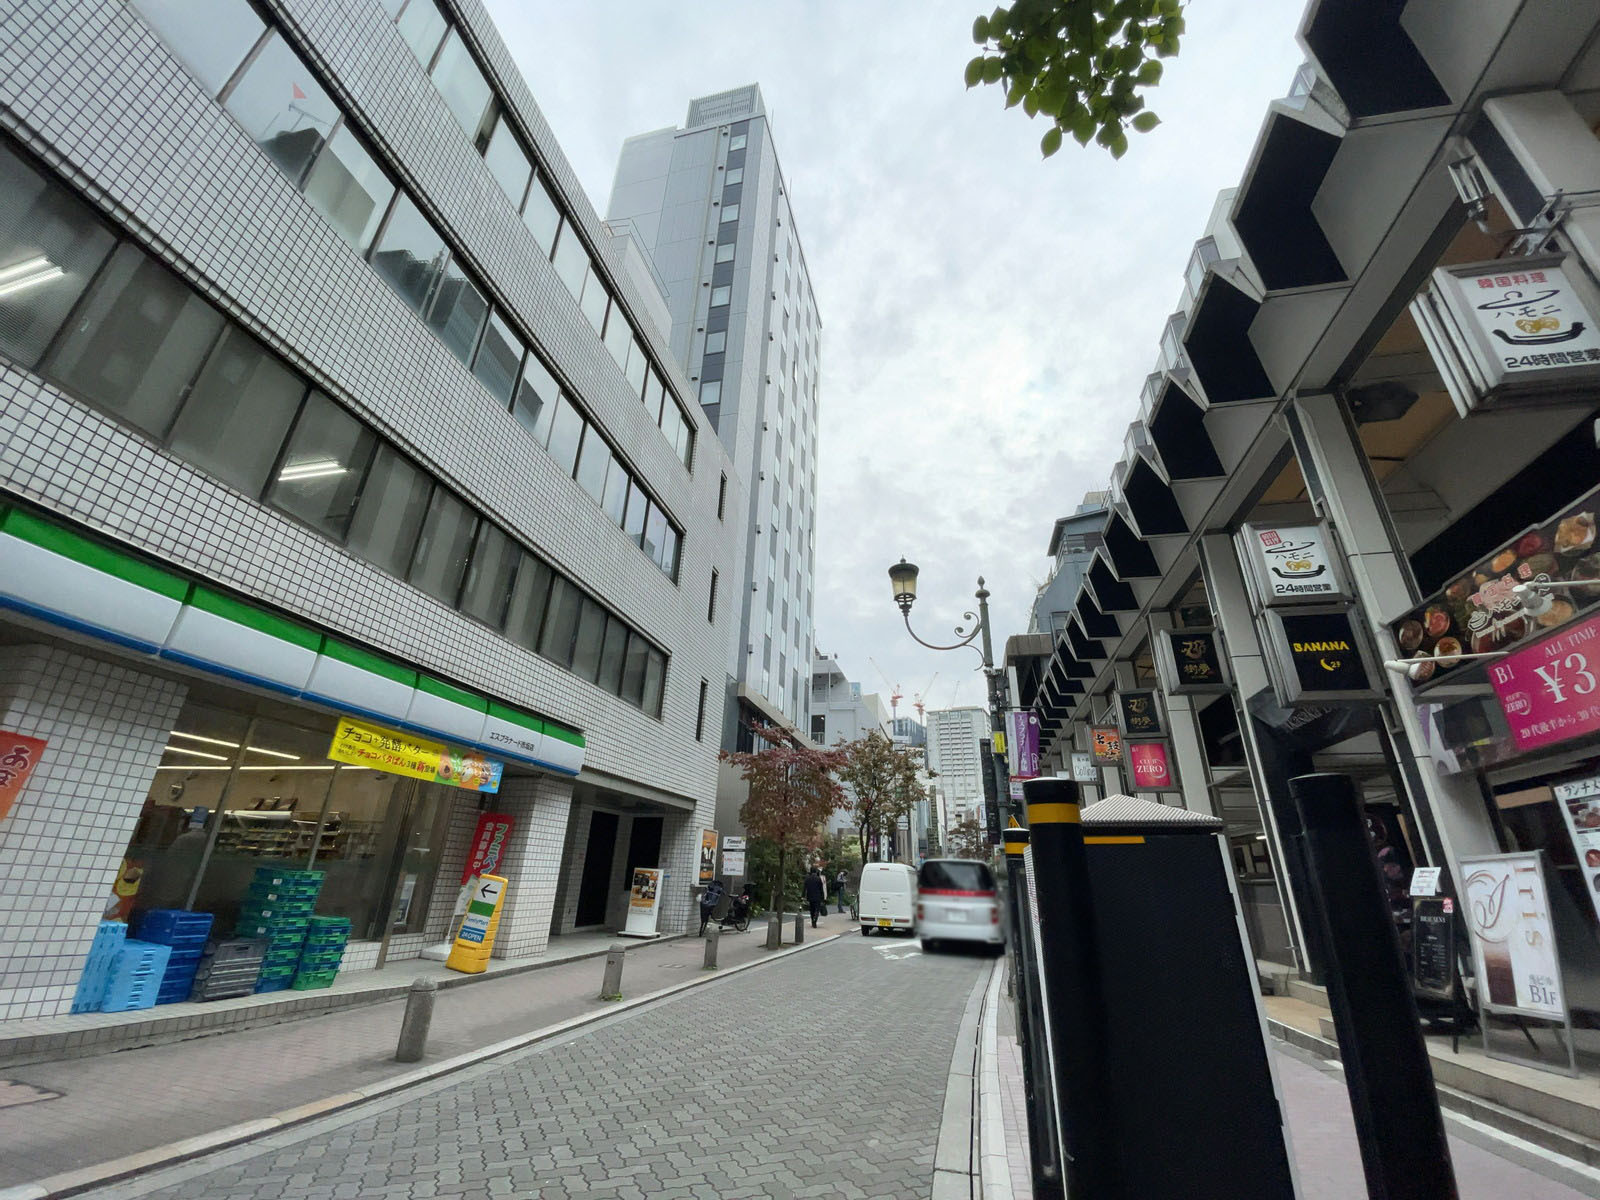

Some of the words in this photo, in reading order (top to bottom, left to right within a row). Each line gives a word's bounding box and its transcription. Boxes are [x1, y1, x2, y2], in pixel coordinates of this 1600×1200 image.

[1476, 272, 1549, 289] 韓国料理
[1495, 305, 1563, 319] ハモニ
[1275, 552, 1316, 561] ハモニ
[1275, 583, 1333, 594] 24時間営業
[1293, 640, 1350, 652] BANANA
[1544, 641, 1565, 658] ALL
[1568, 625, 1598, 646] TIME
[1504, 698, 1528, 713] ZERO
[1136, 765, 1163, 773] ZERO
